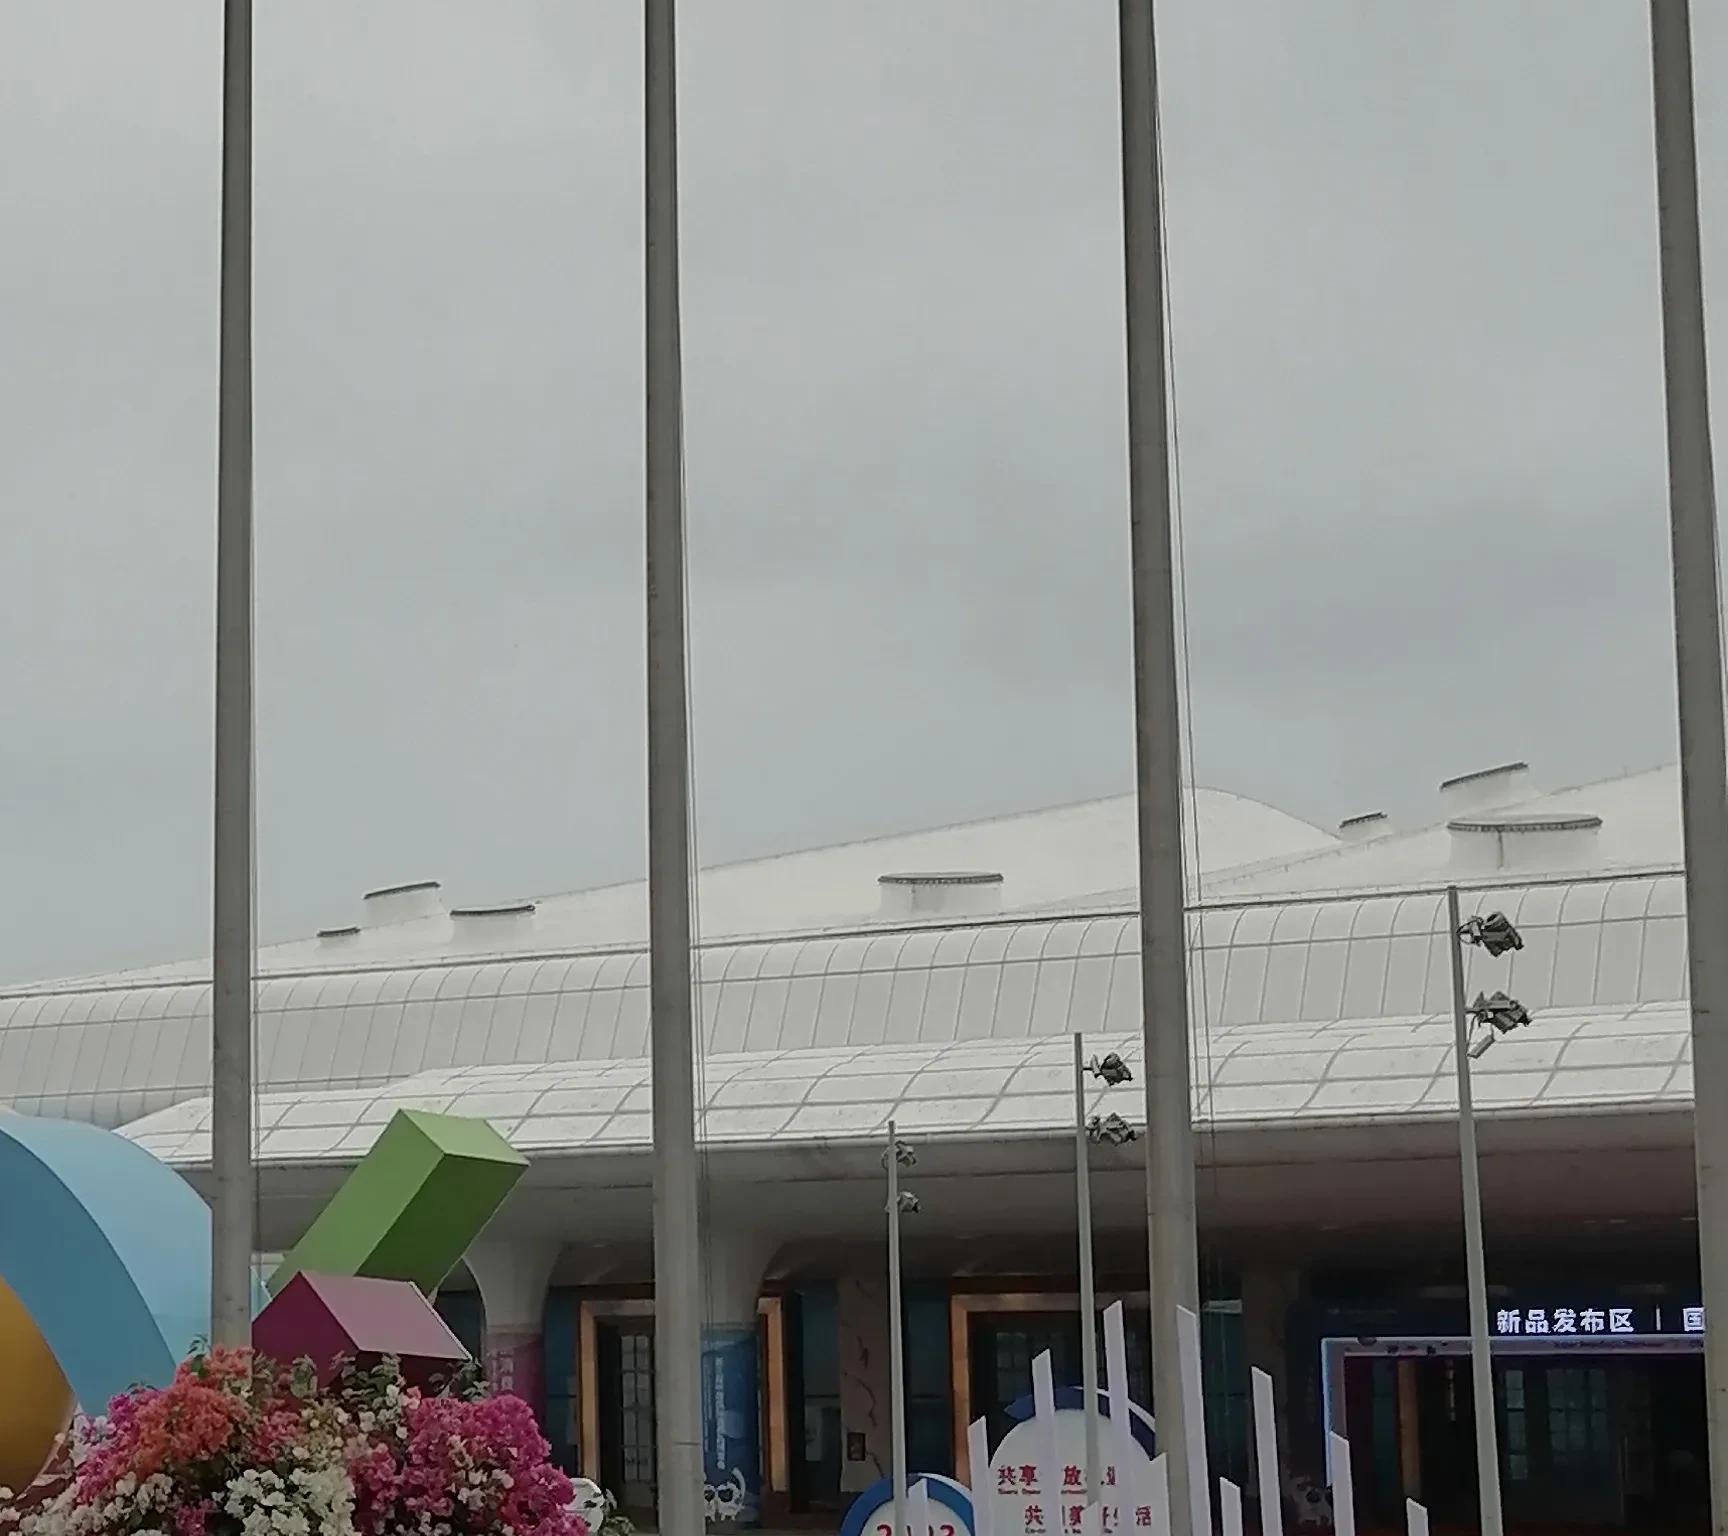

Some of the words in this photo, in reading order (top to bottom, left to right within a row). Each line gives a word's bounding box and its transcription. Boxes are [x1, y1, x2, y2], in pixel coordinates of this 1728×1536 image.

[1496, 1307, 1634, 1333] 新品发布区
